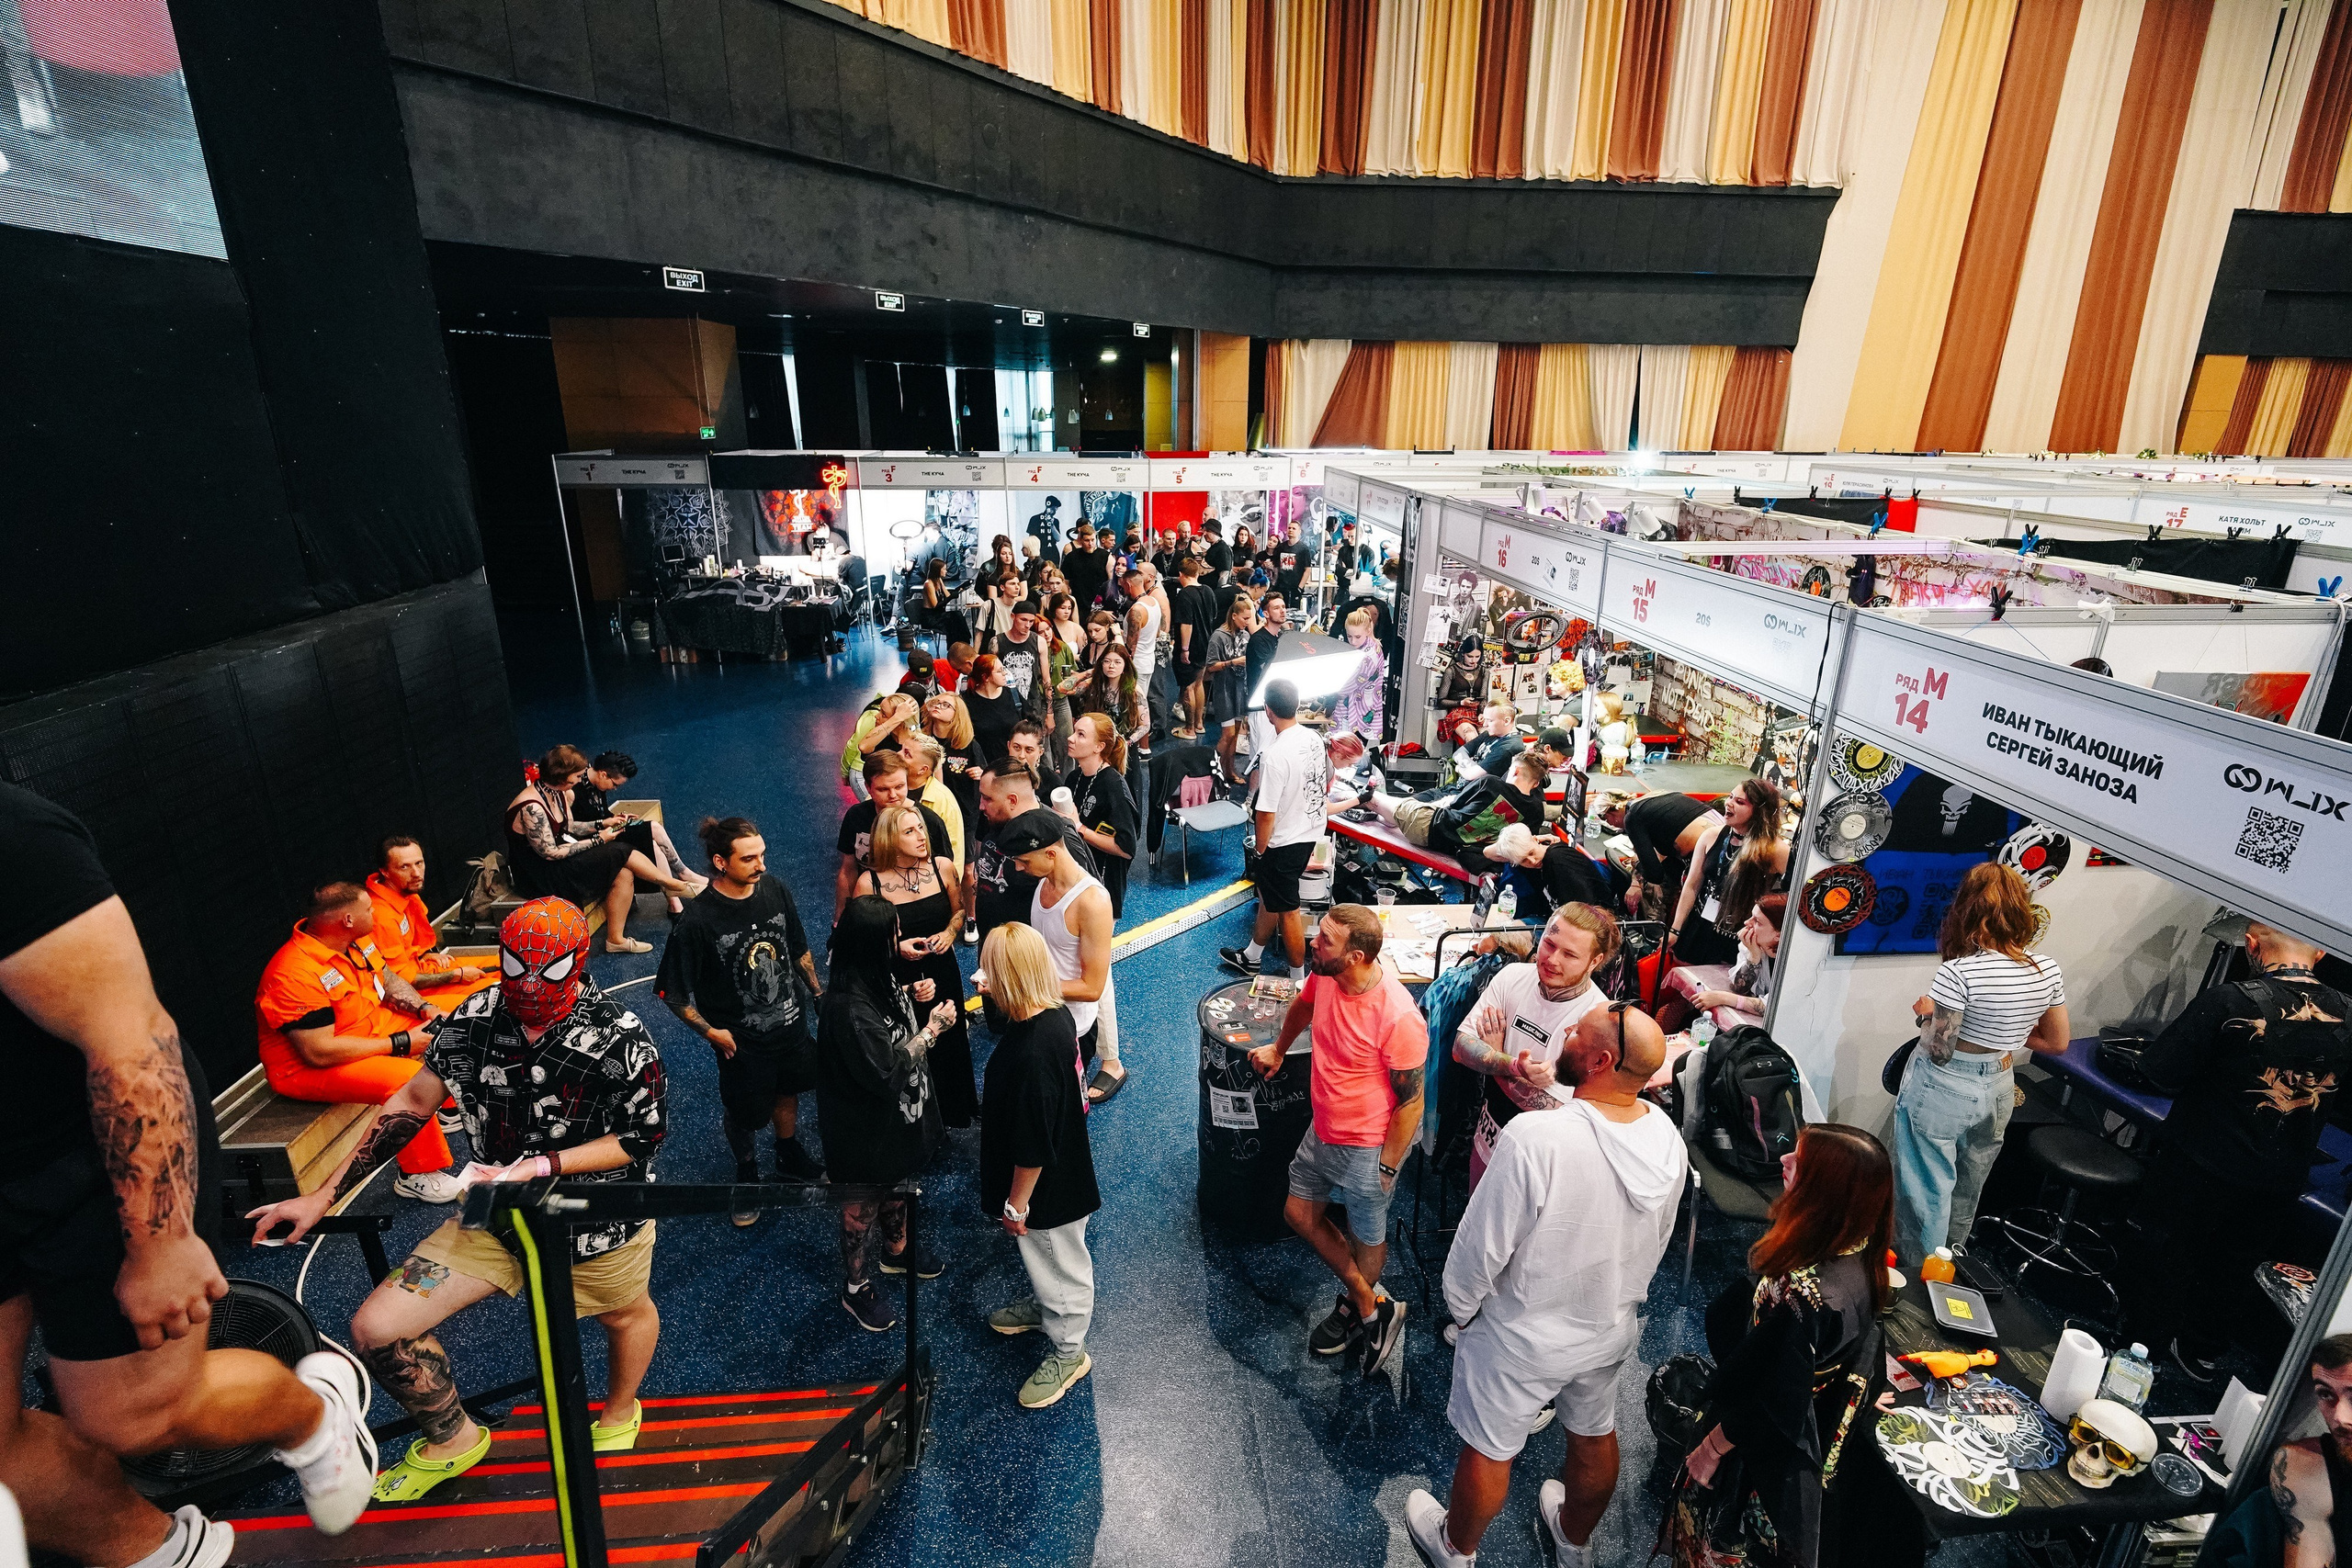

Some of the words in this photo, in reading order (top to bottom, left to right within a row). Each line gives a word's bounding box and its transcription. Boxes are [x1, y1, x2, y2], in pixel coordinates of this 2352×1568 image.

[670, 271, 698, 283] ВЫХОД
[676, 279, 694, 288] EXIT
[891, 465, 896, 473] F
[1300, 469, 1306, 478] 6
[586, 471, 593, 481] 1
[885, 473, 892, 482] 3
[1031, 474, 1038, 483] 4
[1176, 475, 1182, 484] 5
[2166, 519, 2183, 527] 17
[2219, 515, 2239, 524] КАТЯ
[2239, 517, 2267, 526] ХОЛЬТ
[1498, 549, 1507, 568] 16
[1633, 584, 1644, 597] РЯД
[1633, 597, 1649, 624] 15
[1673, 661, 1712, 699] PUNKS
[1895, 671, 1919, 695] РЯД
[1661, 682, 1685, 710] NOT
[1683, 695, 1715, 732] DEAD
[1894, 693, 1929, 735] 14
[1982, 702, 2030, 736] ИВАН
[2033, 716, 2165, 781] ТЫКАЮЩИЙ
[1985, 732, 2054, 771] СЕРГЕЙ
[2054, 756, 2139, 805] ЗАНОЗА
